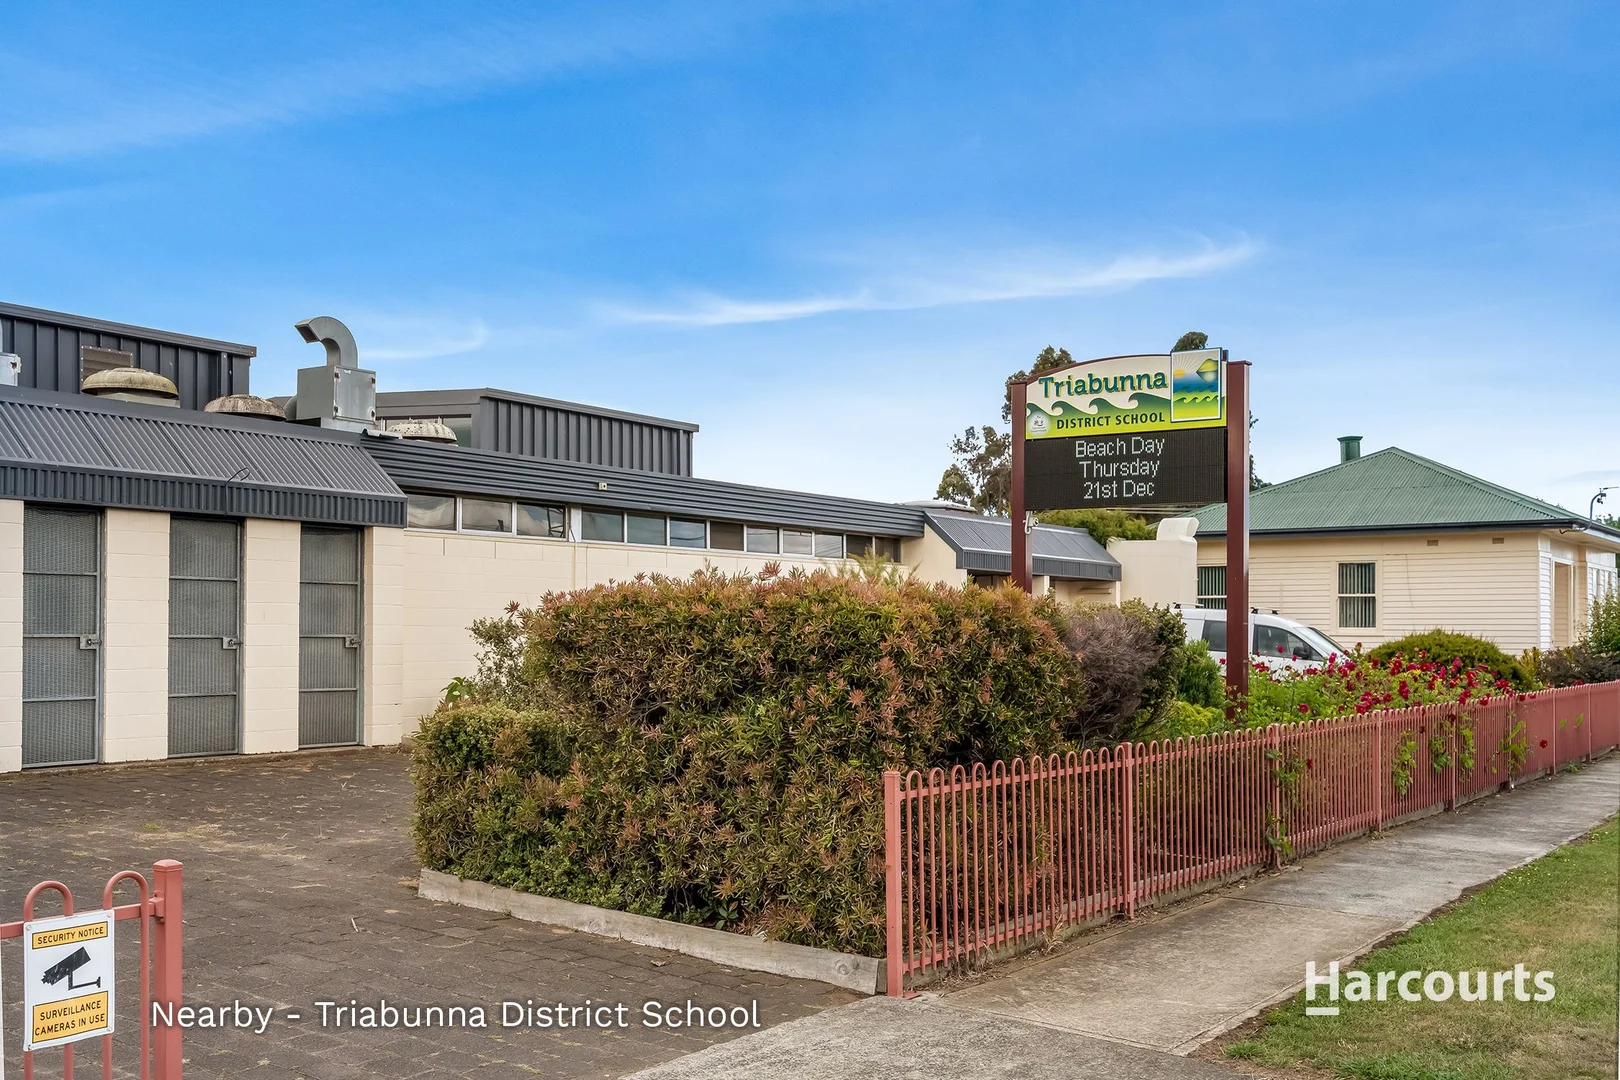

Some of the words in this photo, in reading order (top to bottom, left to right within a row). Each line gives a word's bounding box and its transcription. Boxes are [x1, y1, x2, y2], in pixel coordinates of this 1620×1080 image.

[1038, 371, 1168, 398] Triabunna
[1056, 415, 1111, 430] DISTRICT
[1115, 412, 1165, 426] SCHOOL
[1075, 438, 1126, 458] Beach
[1131, 436, 1165, 456] Day
[1079, 458, 1160, 478] Thursday
[1083, 481, 1118, 499] 21st
[1123, 480, 1155, 498] Dec
[37, 931, 76, 945] SECURITY
[78, 926, 104, 938] NOTICE
[40, 1000, 101, 1021] SURVEILLANCE
[34, 1021, 76, 1036] CAMERAS
[78, 1017, 87, 1027] IN
[89, 1013, 105, 1024] USE
